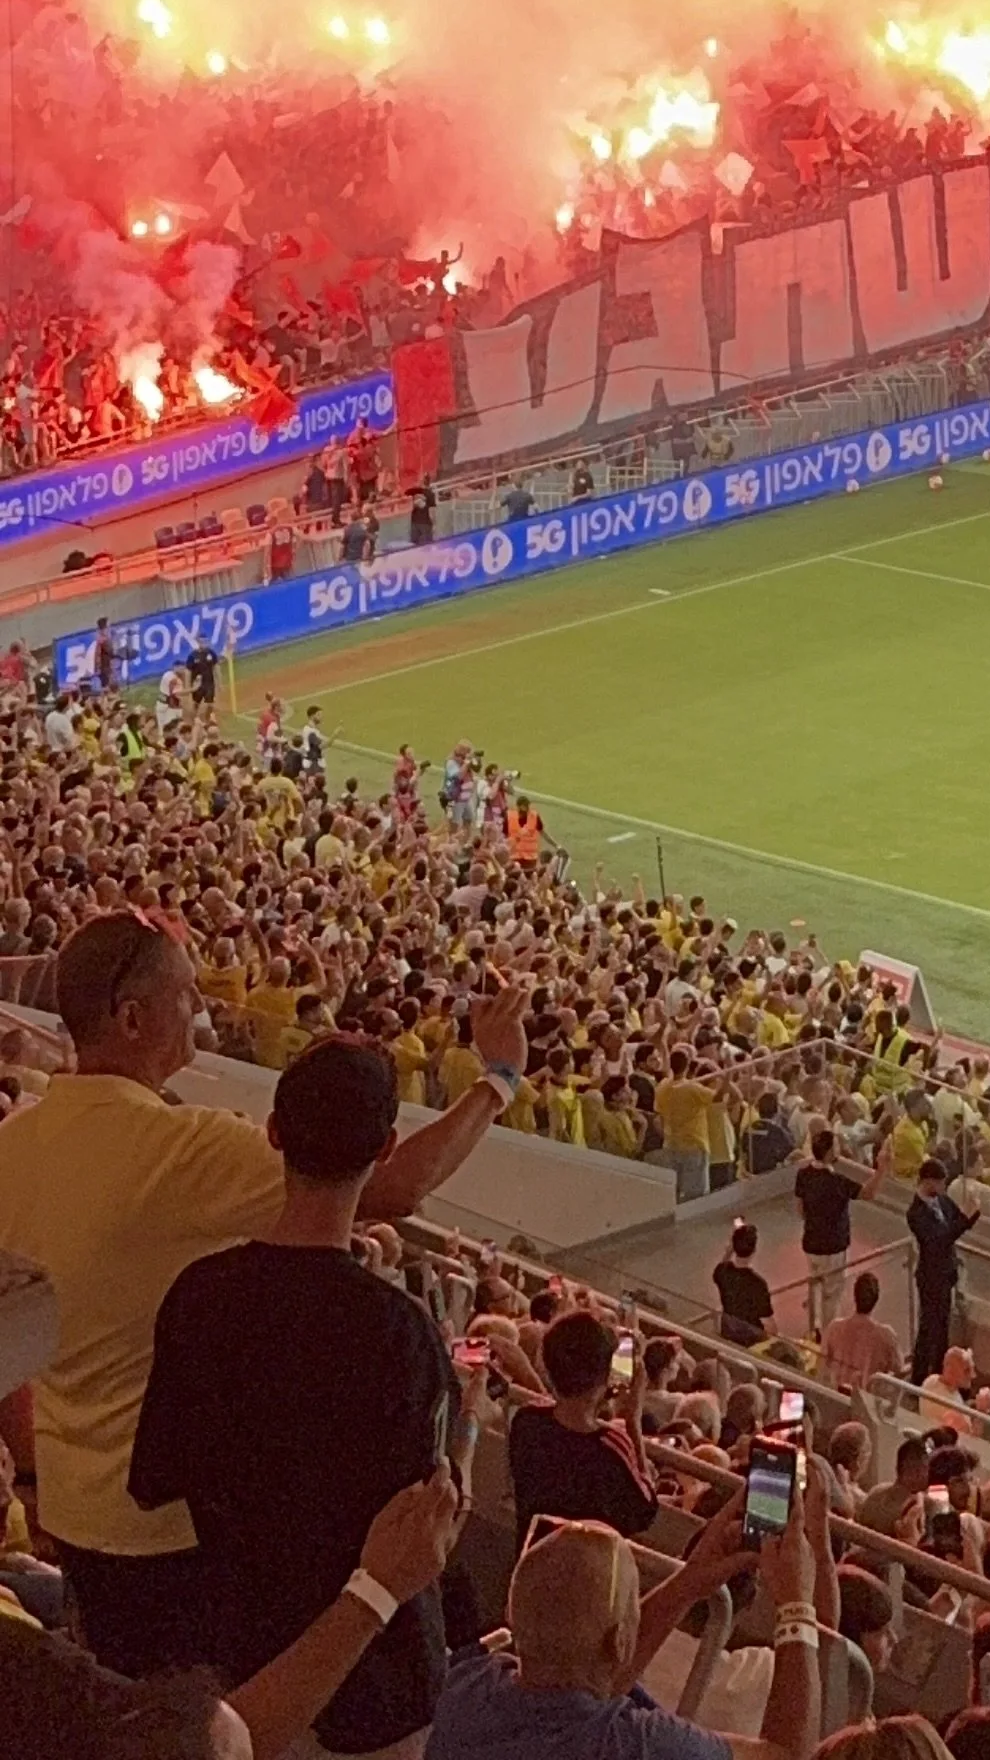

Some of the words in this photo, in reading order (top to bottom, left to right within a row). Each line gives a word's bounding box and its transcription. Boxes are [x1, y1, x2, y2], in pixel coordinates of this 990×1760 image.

[305, 392, 372, 441] פלאפון
[172, 428, 246, 482] פלאפון
[898, 425, 931, 460] 5G
[142, 456, 170, 486] 5G
[725, 470, 760, 508] 5G
[765, 442, 863, 503] פלאפון
[28, 473, 108, 527] פלאפון
[525, 519, 566, 559] 5G
[571, 490, 678, 556] פלאפון
[309, 576, 352, 618] 5G
